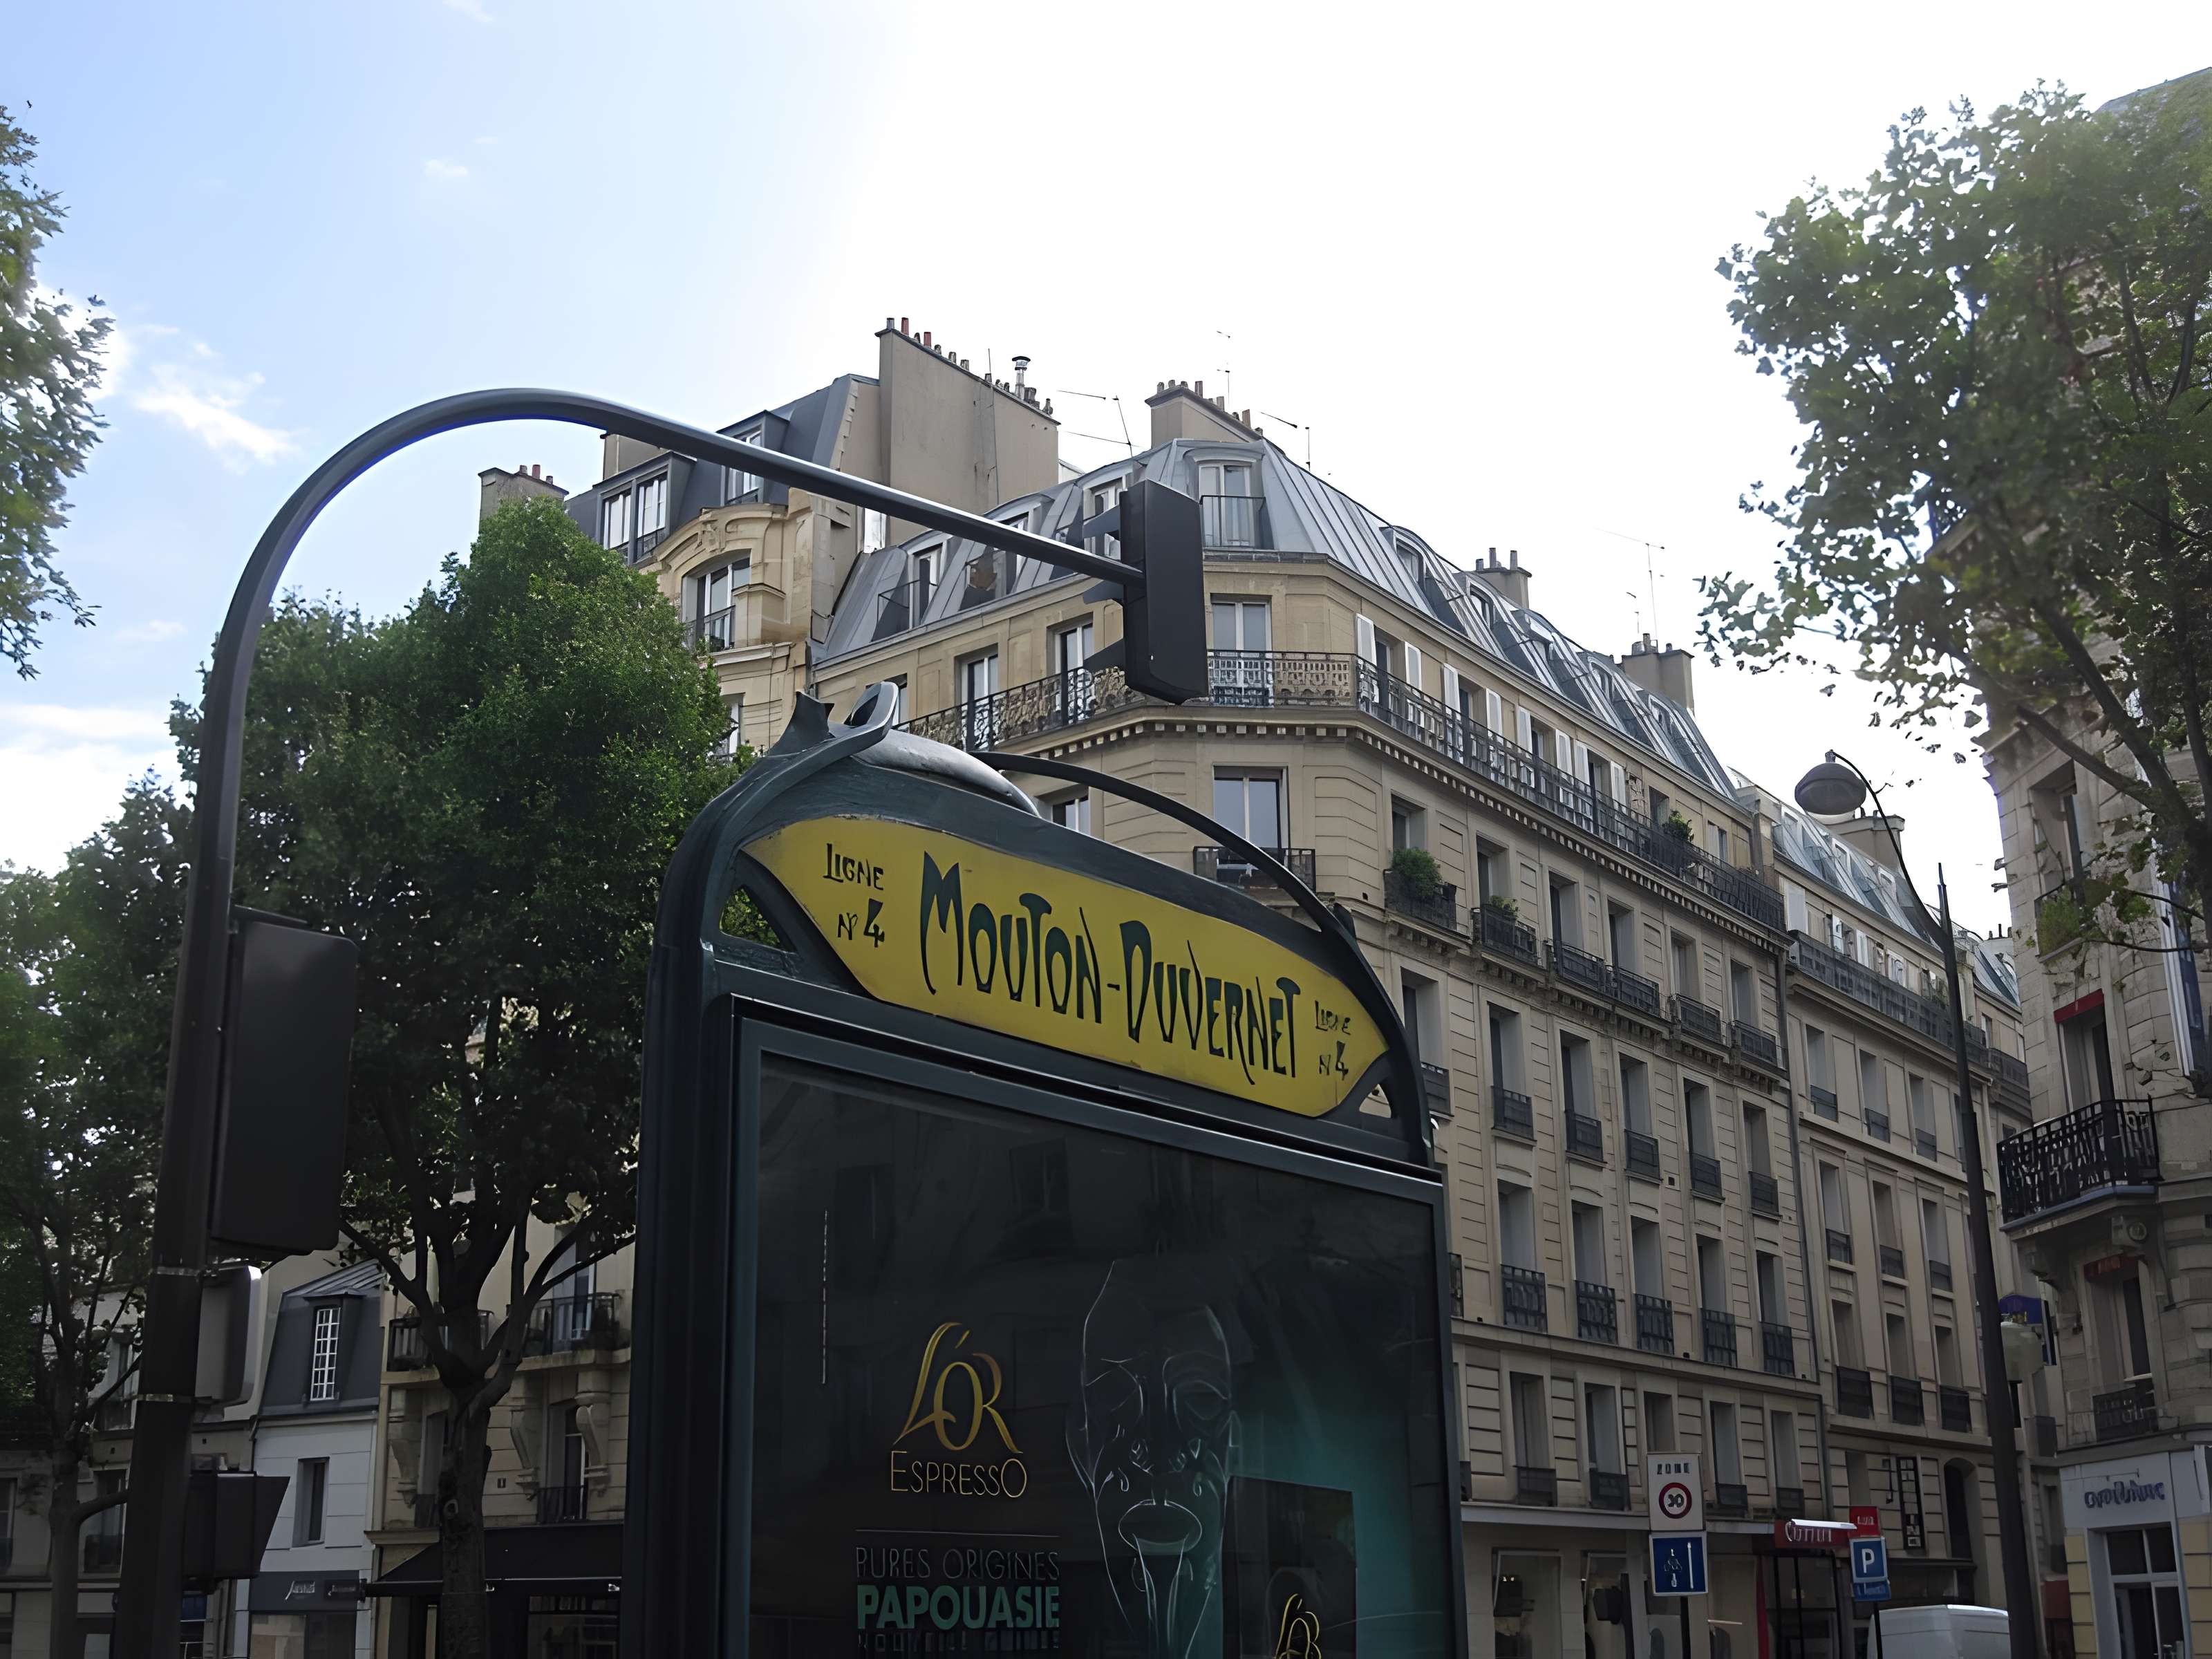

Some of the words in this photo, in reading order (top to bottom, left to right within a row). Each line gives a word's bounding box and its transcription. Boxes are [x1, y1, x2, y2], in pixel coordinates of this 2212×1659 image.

[823, 843, 884, 891] LIGNE
[863, 897, 885, 948] 4
[919, 851, 1301, 1085] MOUTON-DUVERNET
[1335, 1040, 1349, 1082] 4
[893, 1321, 1023, 1454] L'OR
[890, 1450, 1028, 1498] ESPRESSO
[855, 1546, 931, 1580] PURES
[942, 1548, 1060, 1582] ORIGINES
[1861, 1548, 1875, 1574] P
[856, 1583, 1061, 1631] PAPOUASIE
